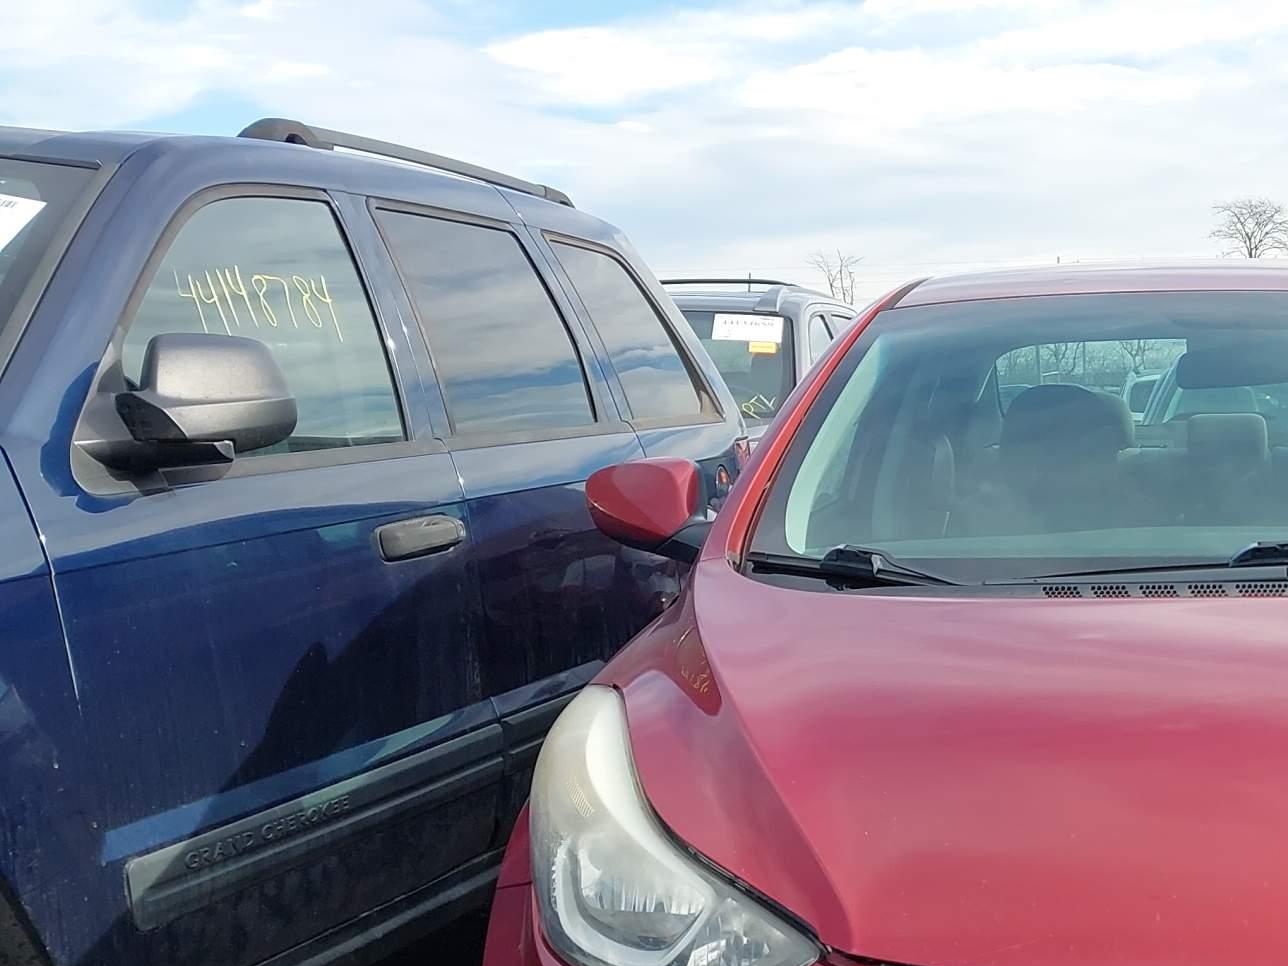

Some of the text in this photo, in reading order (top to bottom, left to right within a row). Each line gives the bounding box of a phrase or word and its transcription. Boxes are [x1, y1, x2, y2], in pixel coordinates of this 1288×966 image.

[173, 265, 344, 342] 44148784
[184, 795, 350, 870] GRAND CHEROKEE
